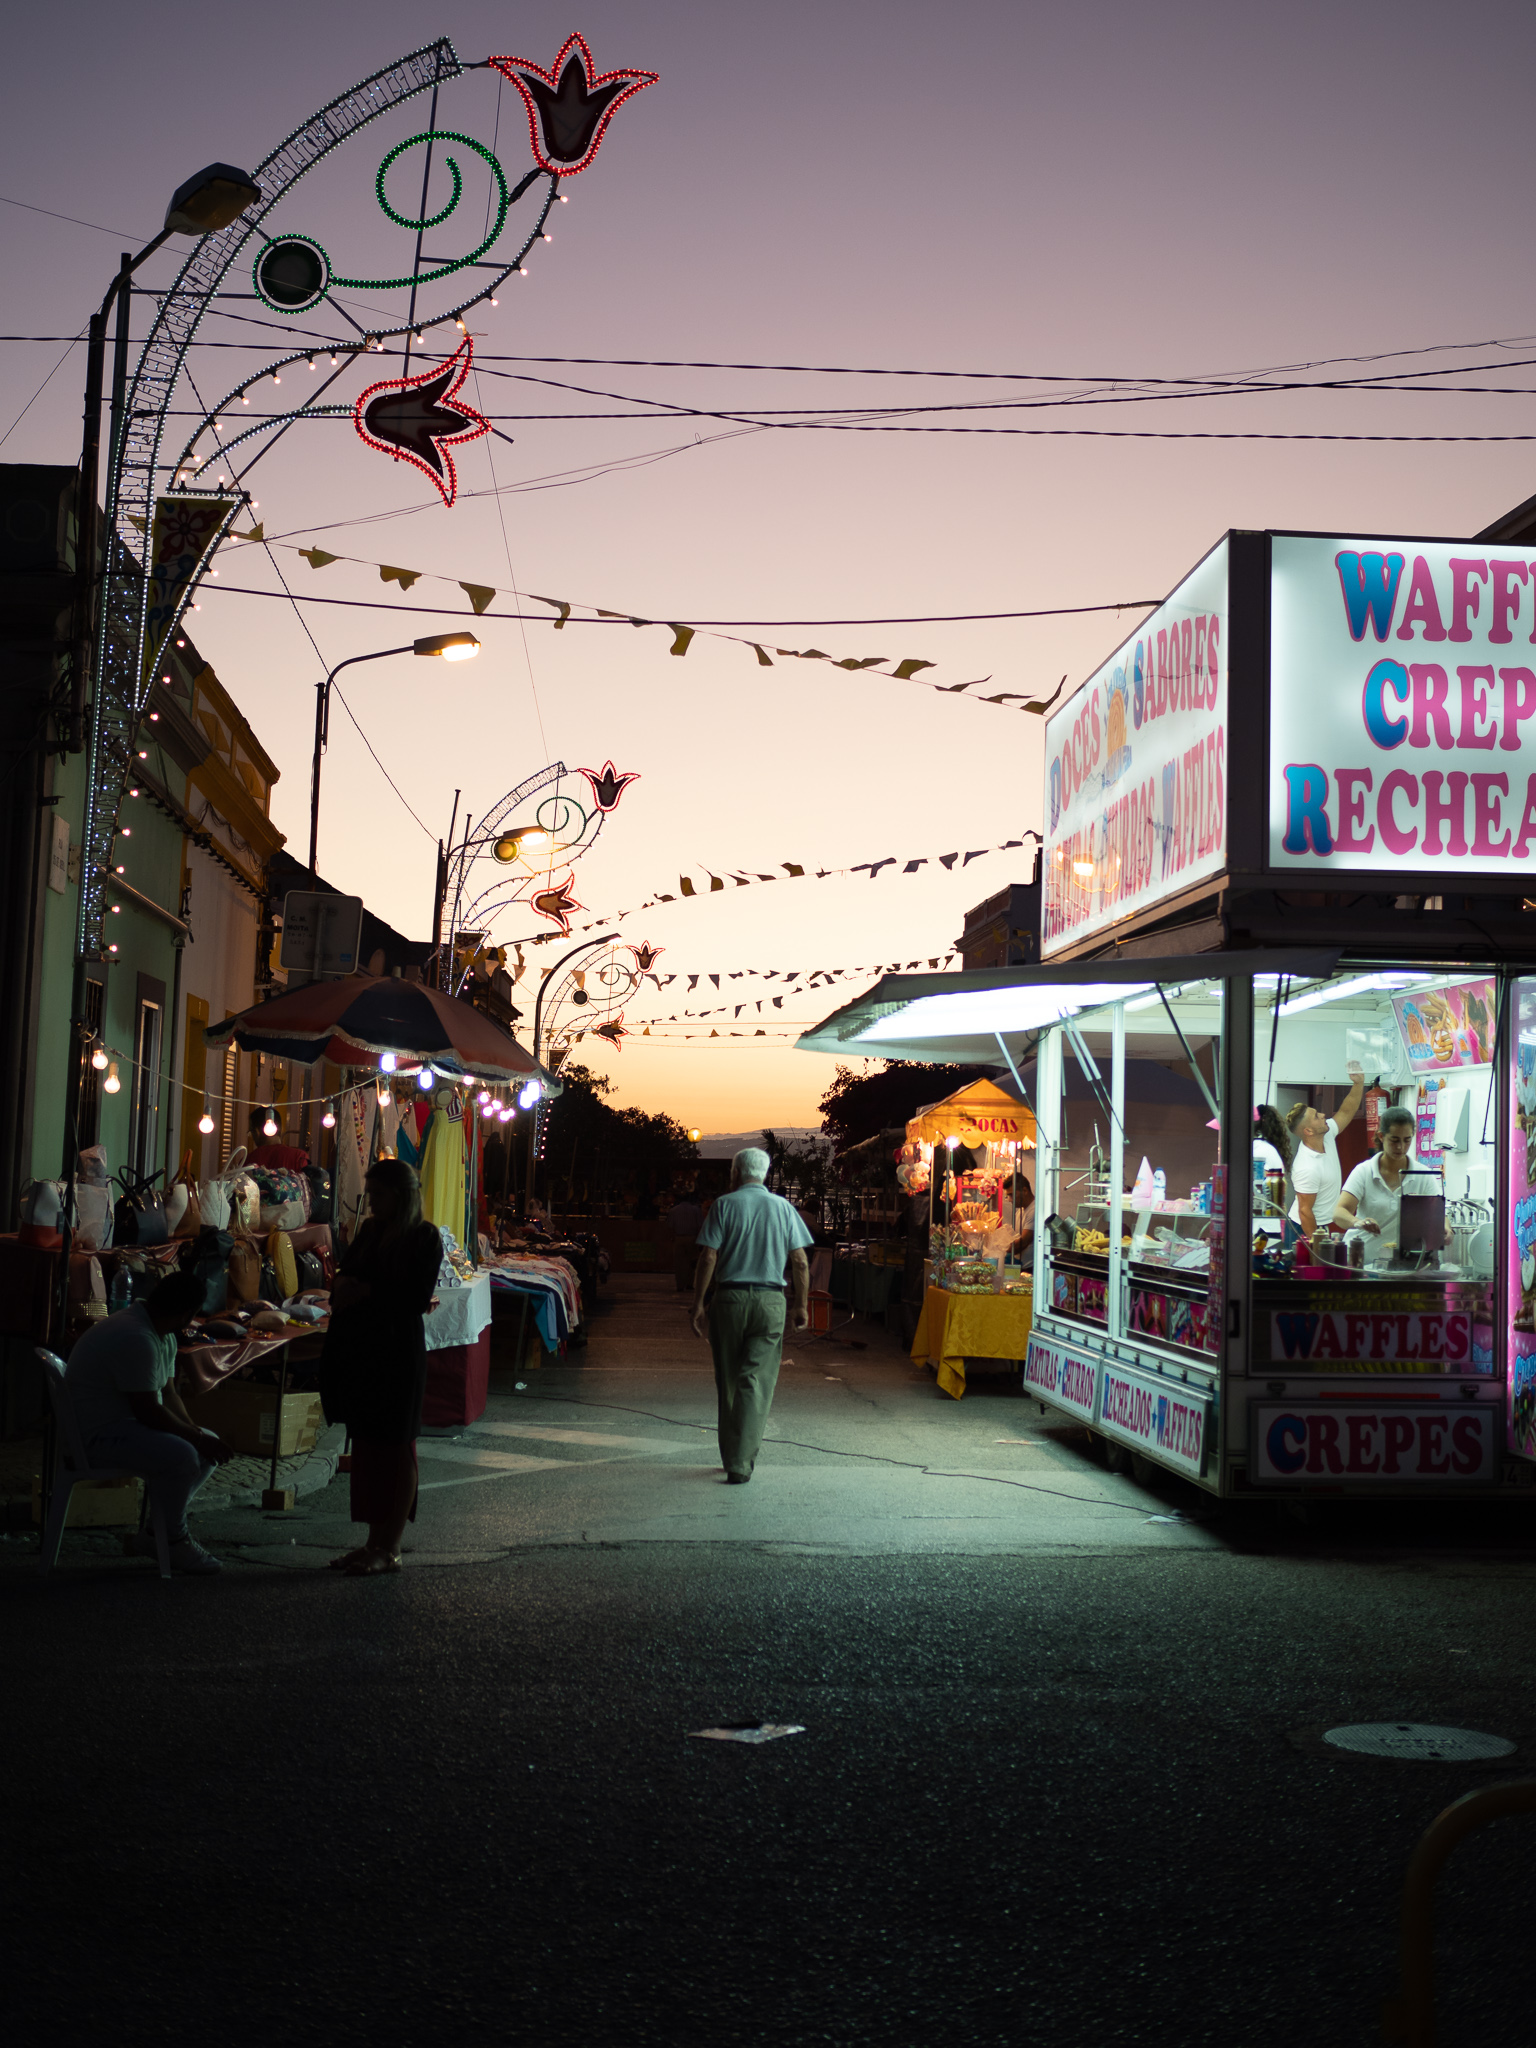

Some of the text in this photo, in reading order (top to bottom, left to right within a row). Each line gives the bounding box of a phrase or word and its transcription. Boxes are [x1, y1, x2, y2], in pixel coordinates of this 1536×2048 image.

[1334, 550, 1536, 645] WAFF
[1049, 613, 1220, 838] DOCES SABORES
[1160, 725, 1224, 884] WAFFLES
[1275, 1312, 1469, 1360] WAFFLES
[1061, 1356, 1095, 1410] CHURROS
[1102, 1372, 1202, 1462] RECHEADOS WAFFLES
[1267, 1413, 1483, 1474] CREPES
